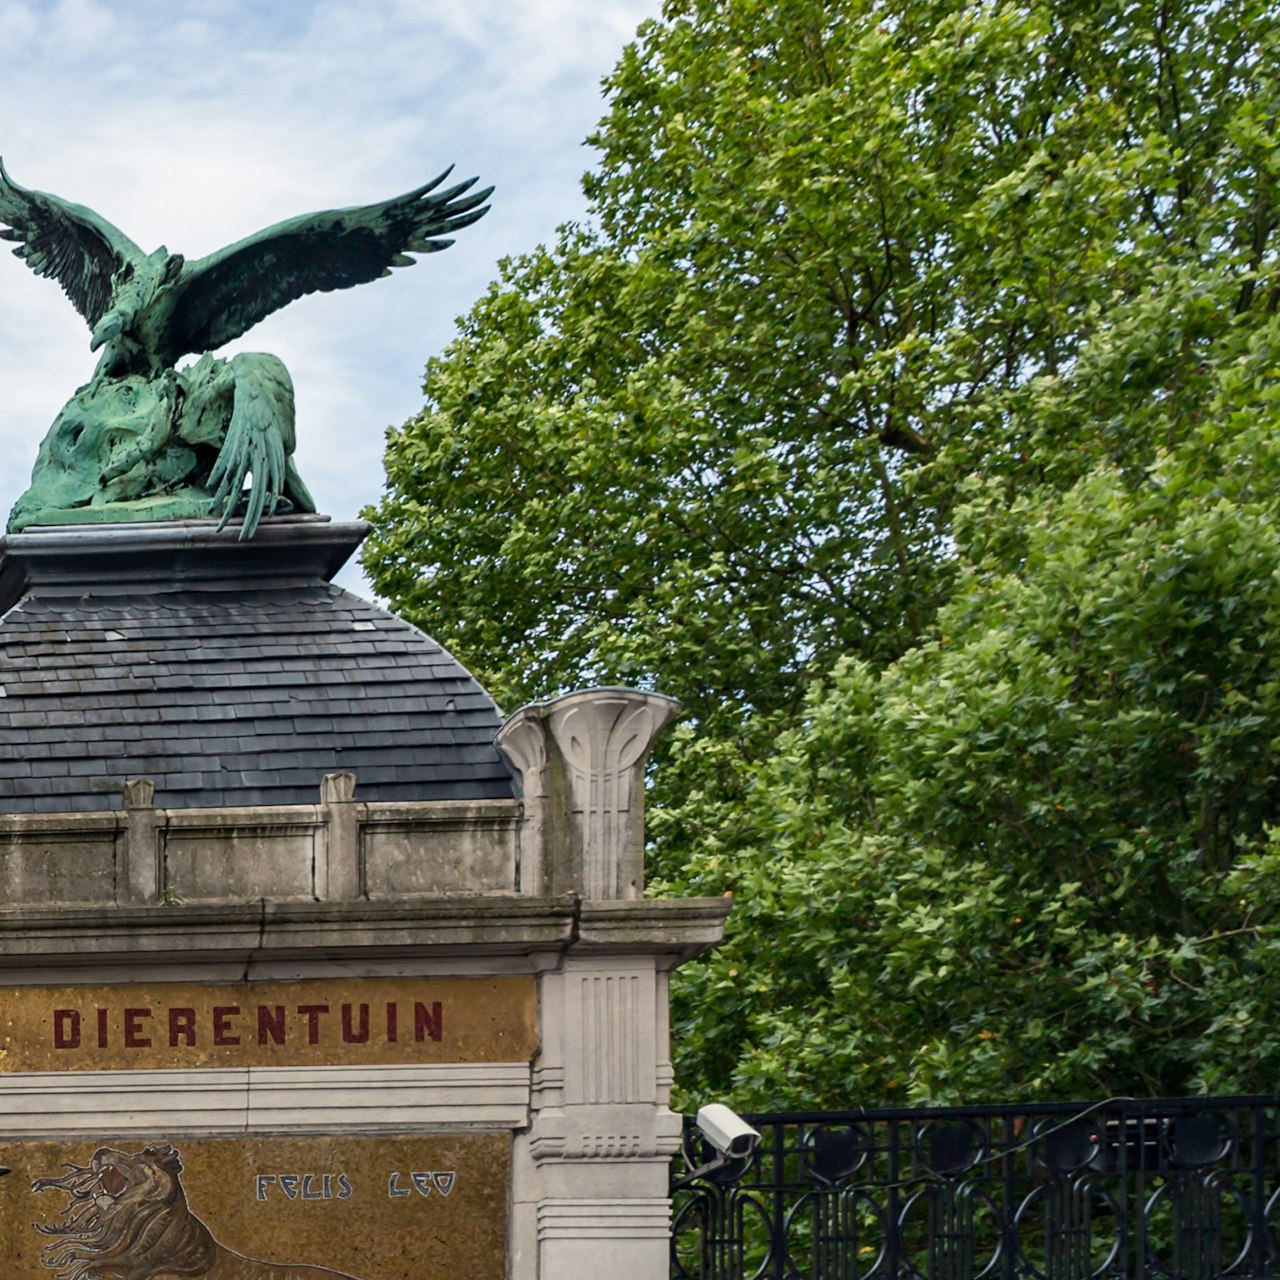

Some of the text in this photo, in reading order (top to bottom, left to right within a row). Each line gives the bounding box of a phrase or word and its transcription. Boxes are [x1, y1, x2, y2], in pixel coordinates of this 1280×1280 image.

[53, 1001, 444, 1049] DIERENTUIN
[257, 1171, 455, 1201] FELIS LEO
